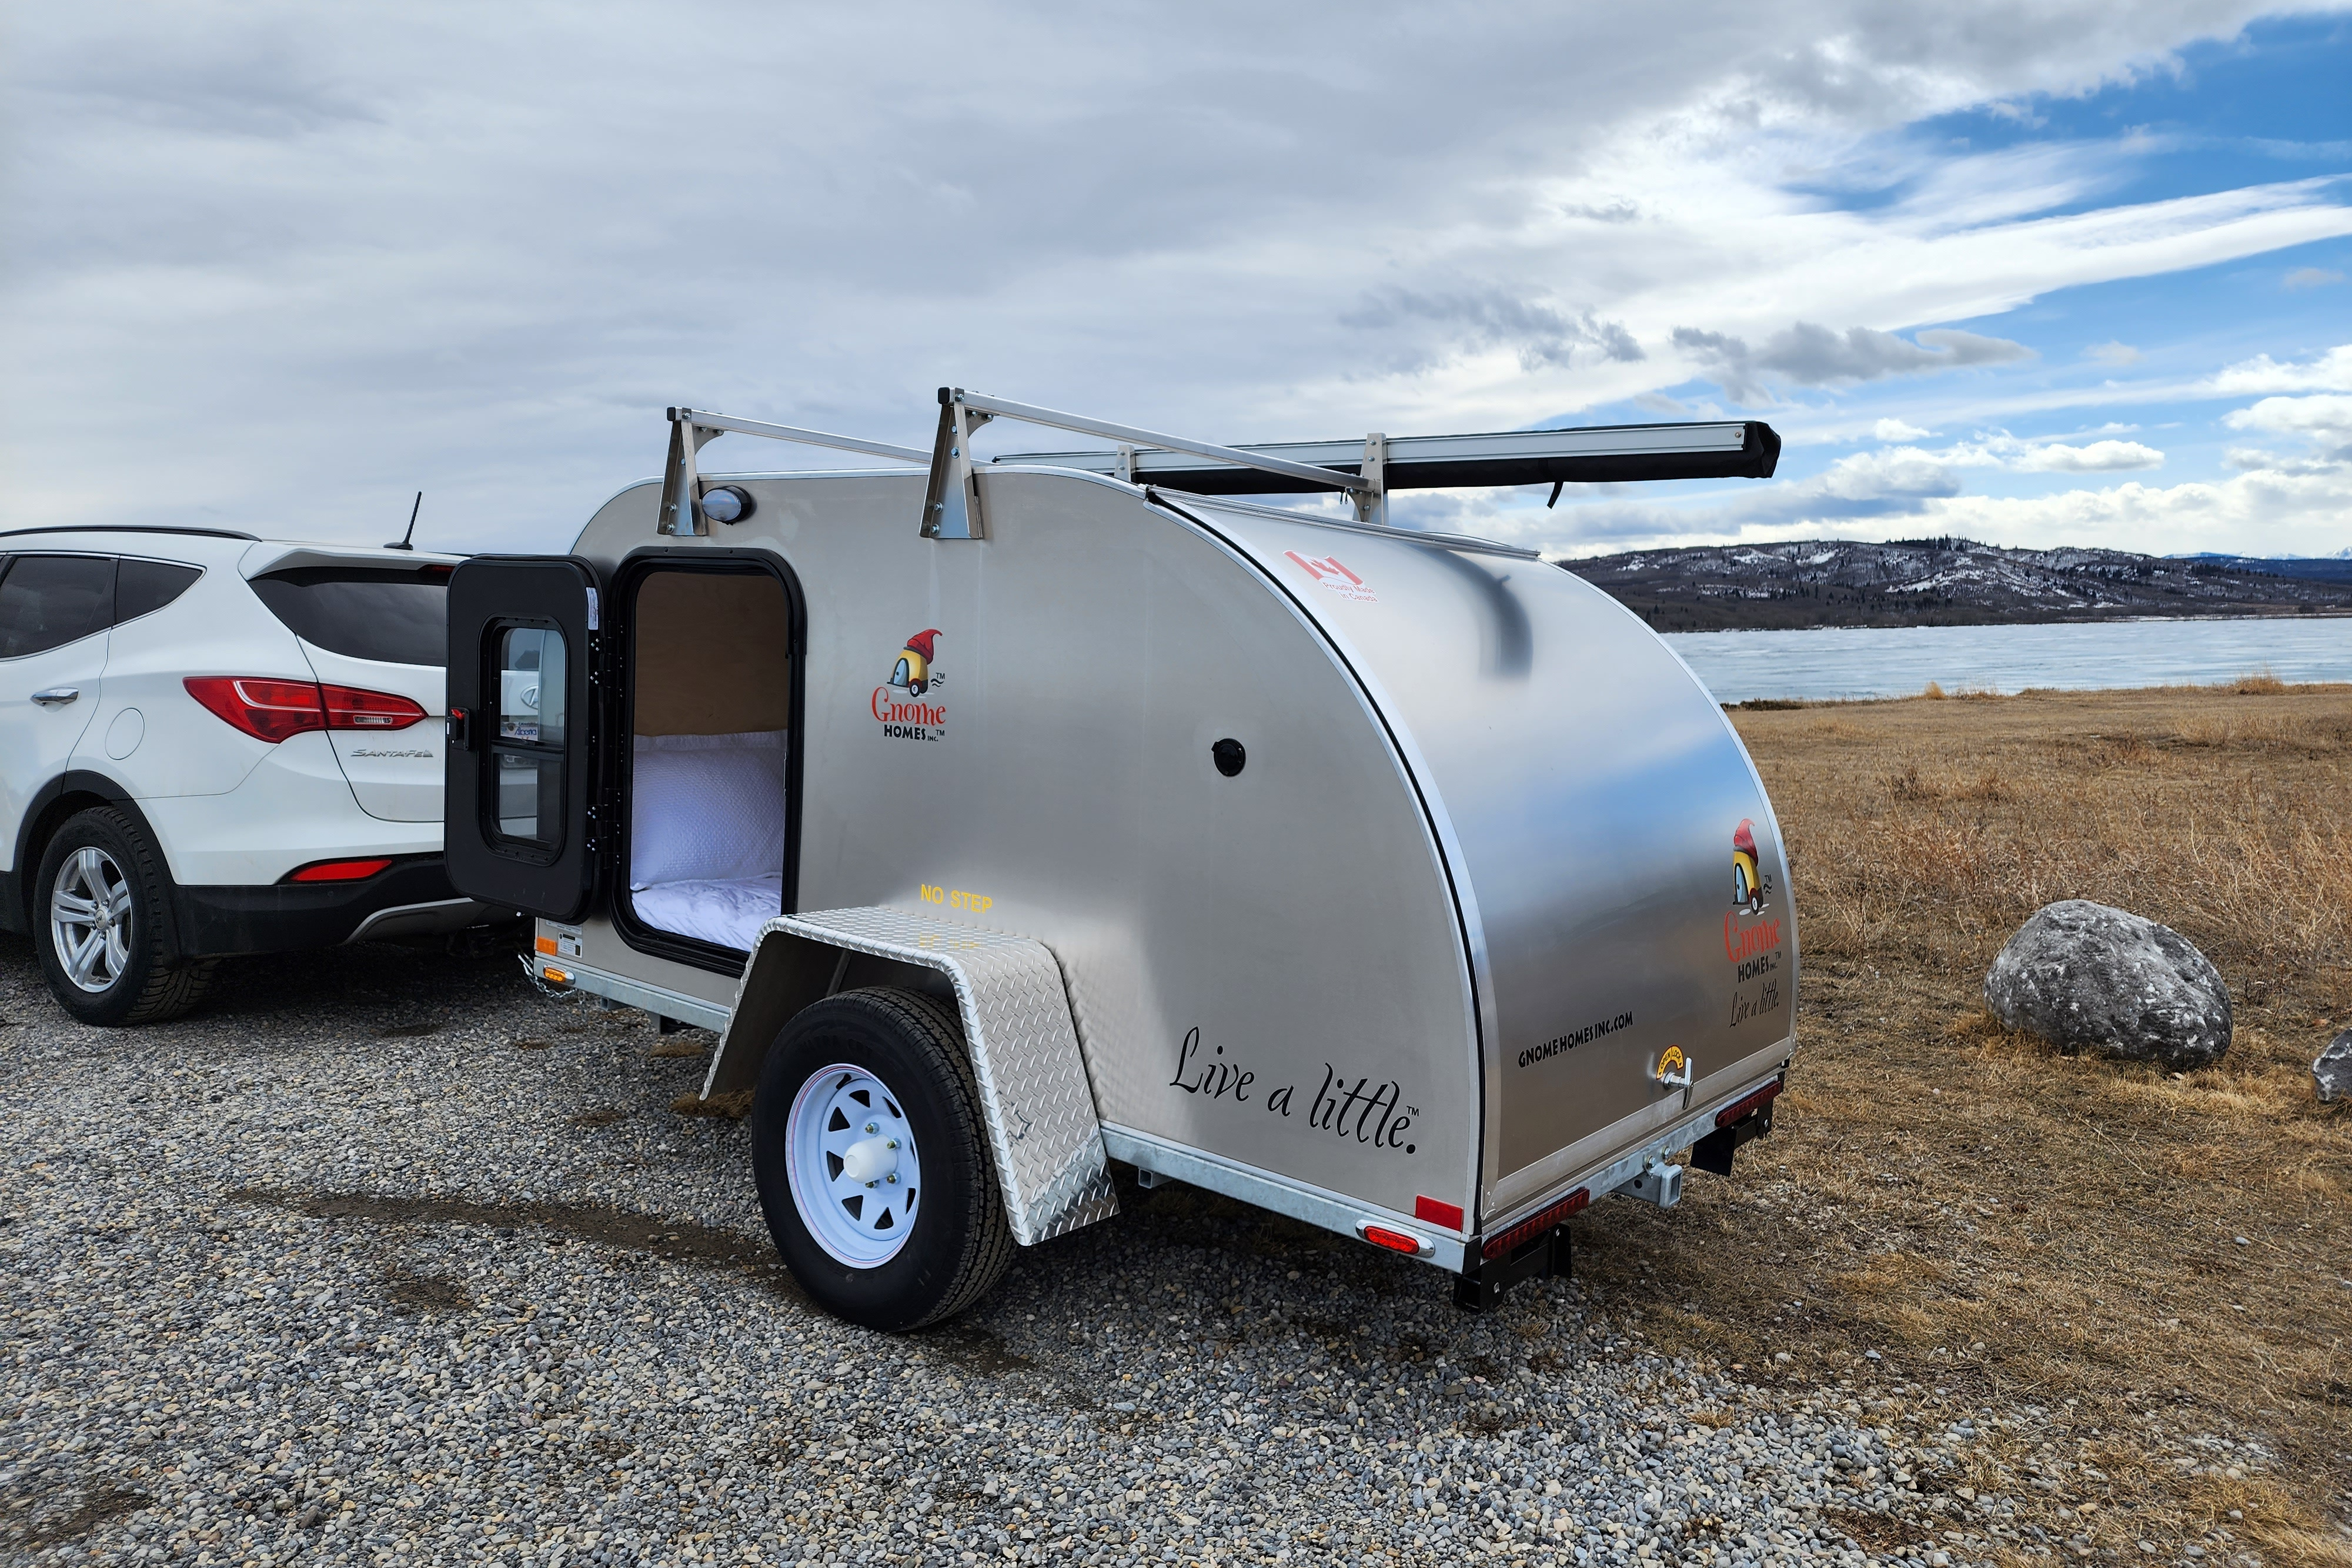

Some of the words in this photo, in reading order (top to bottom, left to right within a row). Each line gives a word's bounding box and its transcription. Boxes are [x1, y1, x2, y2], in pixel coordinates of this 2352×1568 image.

[1322, 582, 1354, 593] Proudly
[1354, 585, 1375, 594] Made
[1349, 593, 1378, 601] Canada
[871, 687, 946, 726] Gnome
[884, 724, 926, 741] HOMES
[921, 884, 944, 904] NO
[950, 890, 993, 914] STEP
[1725, 911, 1781, 962] Gnome
[1738, 955, 1769, 983] HOMES
[1729, 992, 1750, 1028] Live
[1751, 1000, 1757, 1017] a
[1660, 1052, 1671, 1069] OPEN
[1672, 1050, 1681, 1062] LOCK
[1170, 1027, 1254, 1102] Live
[1267, 1085, 1294, 1116] a
[1309, 1062, 1416, 1154] little.
